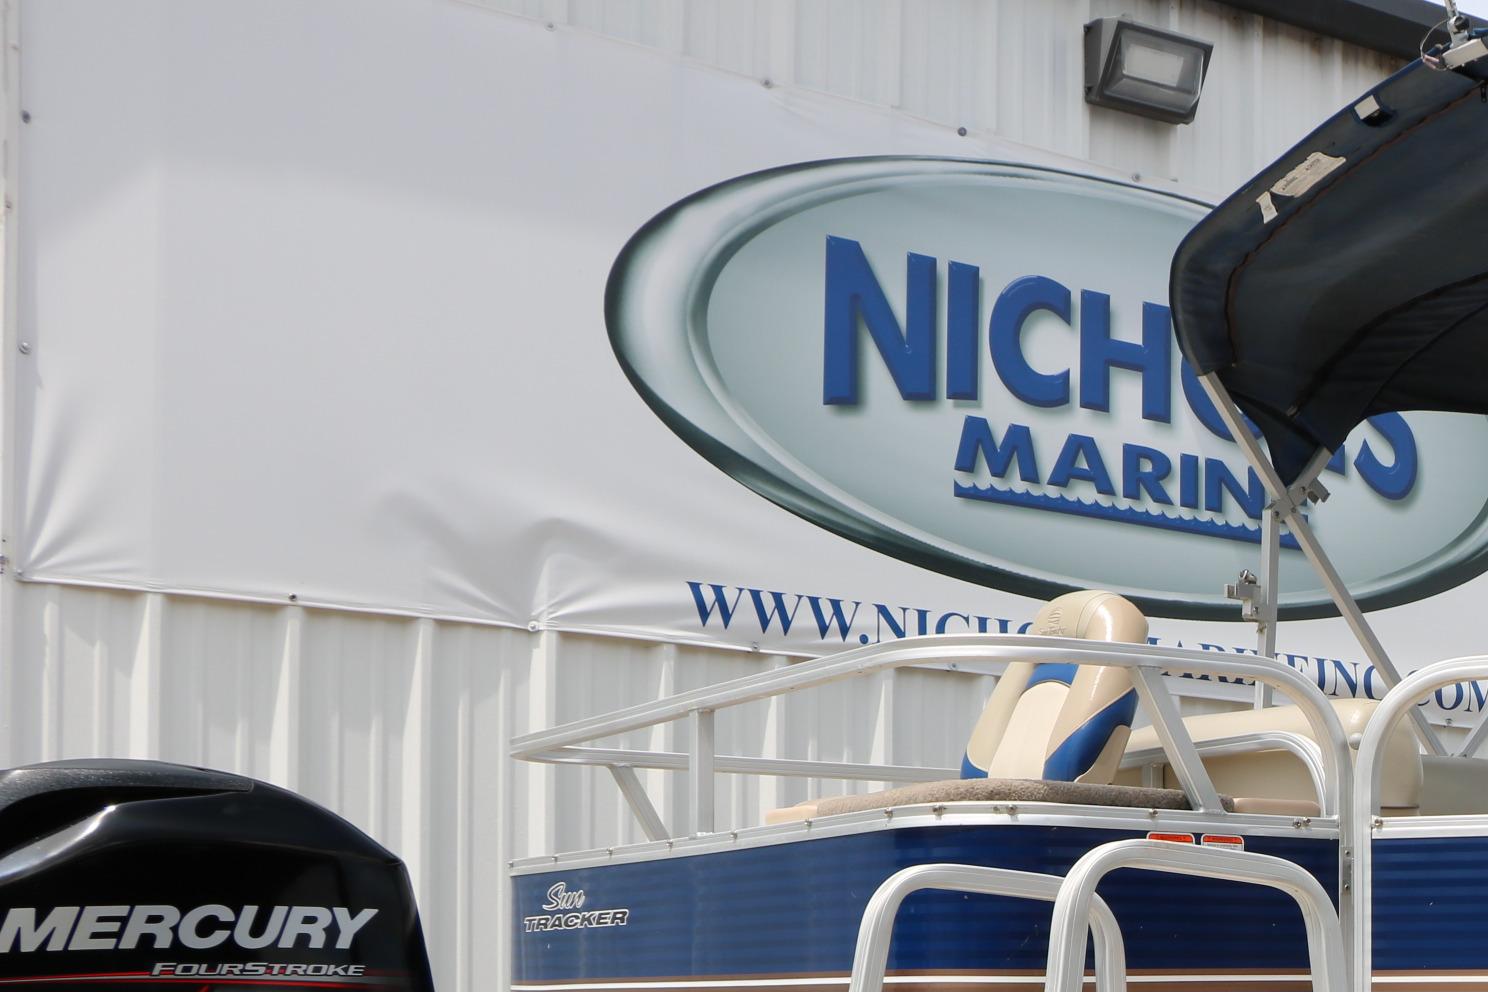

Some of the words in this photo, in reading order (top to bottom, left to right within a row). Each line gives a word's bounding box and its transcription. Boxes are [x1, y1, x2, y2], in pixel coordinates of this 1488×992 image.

[953, 415, 1309, 527] MARIN
[542, 882, 586, 911] Sun
[0, 904, 379, 953] MERCURY
[524, 909, 629, 932] TRACKER
